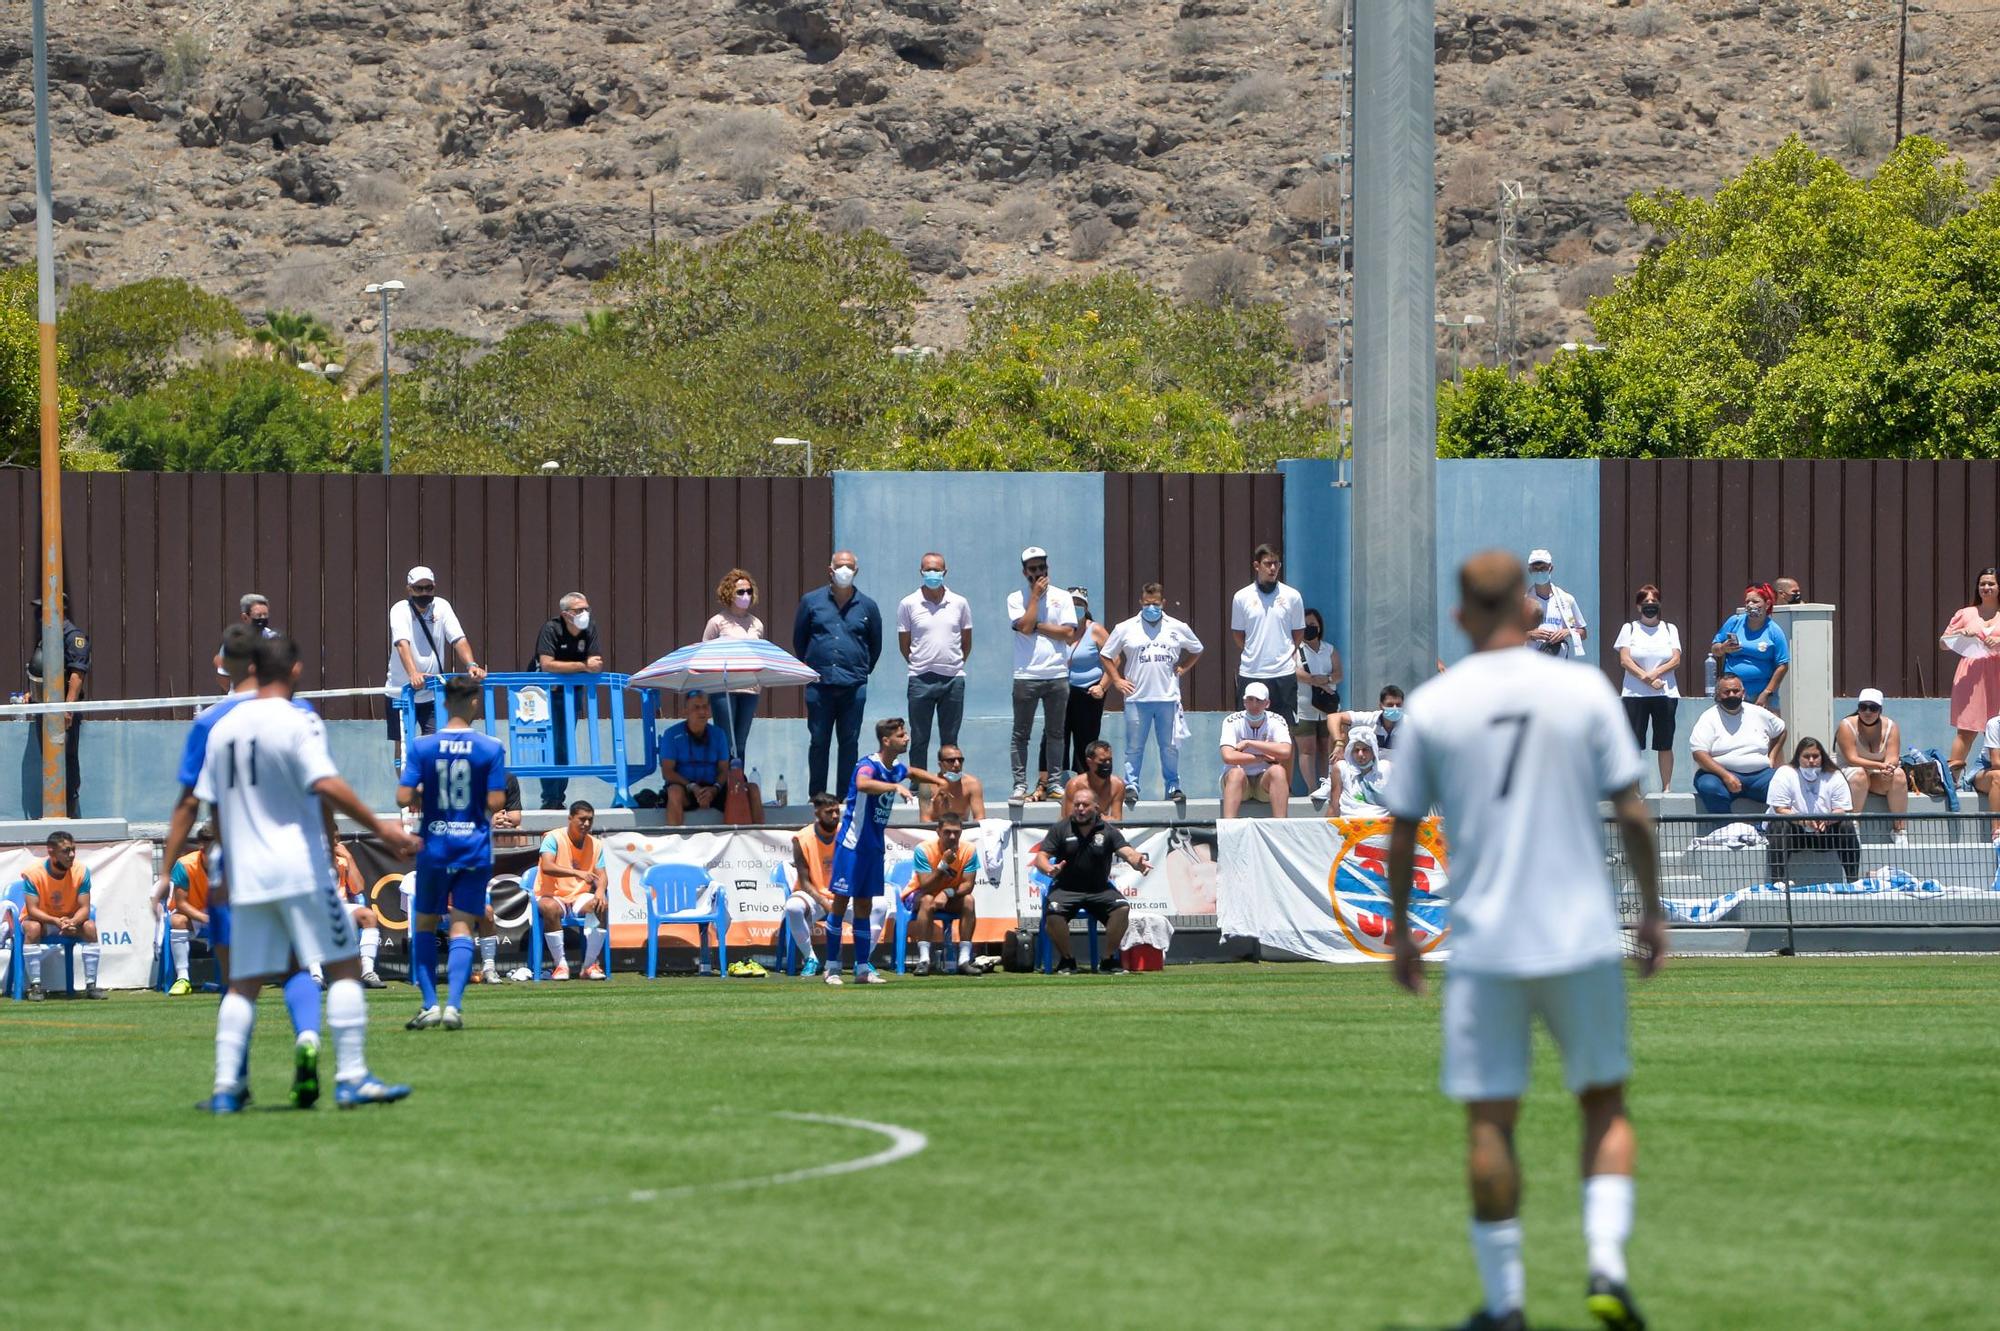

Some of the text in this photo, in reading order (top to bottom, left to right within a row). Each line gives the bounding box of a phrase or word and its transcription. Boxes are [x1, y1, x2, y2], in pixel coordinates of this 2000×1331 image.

[226, 739, 256, 788] 11
[1489, 711, 1528, 800] 7
[435, 758, 472, 810] 18
[101, 931, 132, 945] RIA
